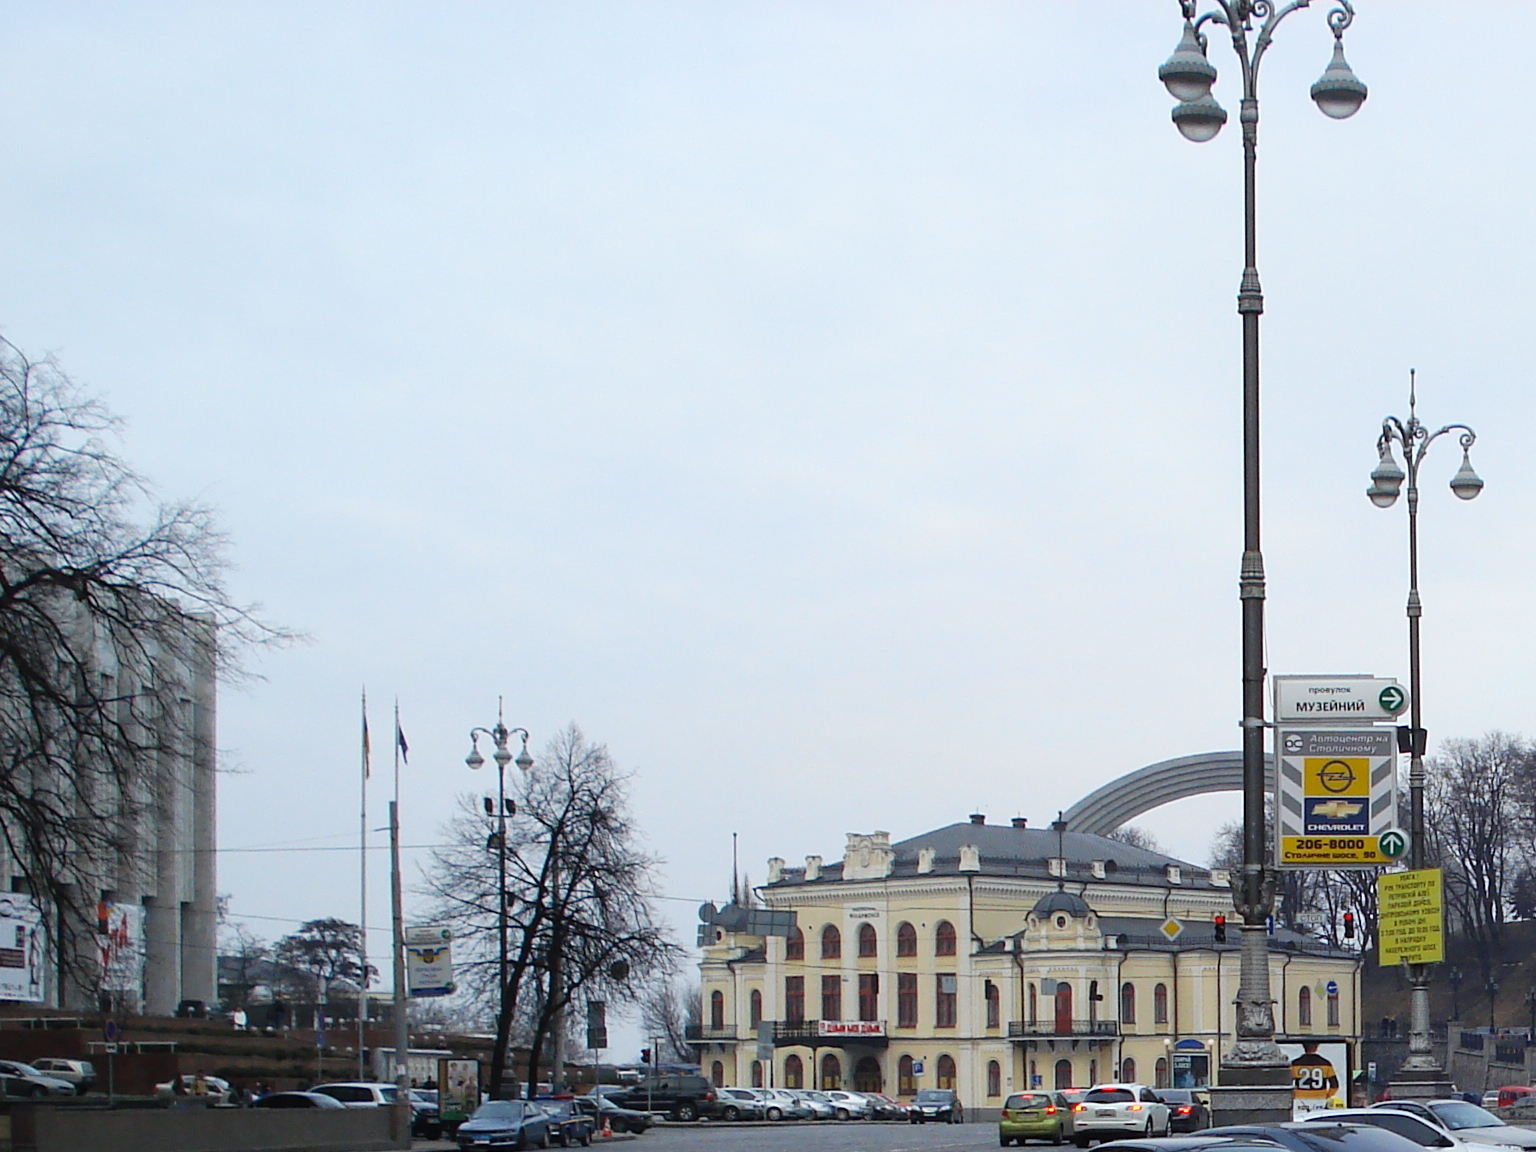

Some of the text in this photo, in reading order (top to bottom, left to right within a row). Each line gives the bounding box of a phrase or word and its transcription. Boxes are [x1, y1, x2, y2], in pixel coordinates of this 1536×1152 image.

[1308, 687, 1352, 695] провулок
[1296, 699, 1365, 713] МУЗЕЙНИЙ
[1309, 734, 1374, 744] Автоцентр
[1309, 744, 1377, 754] Столичному
[1307, 824, 1366, 832] CHEVROLET
[1296, 839, 1365, 850] 206-8000
[1298, 1067, 1324, 1090] 29
